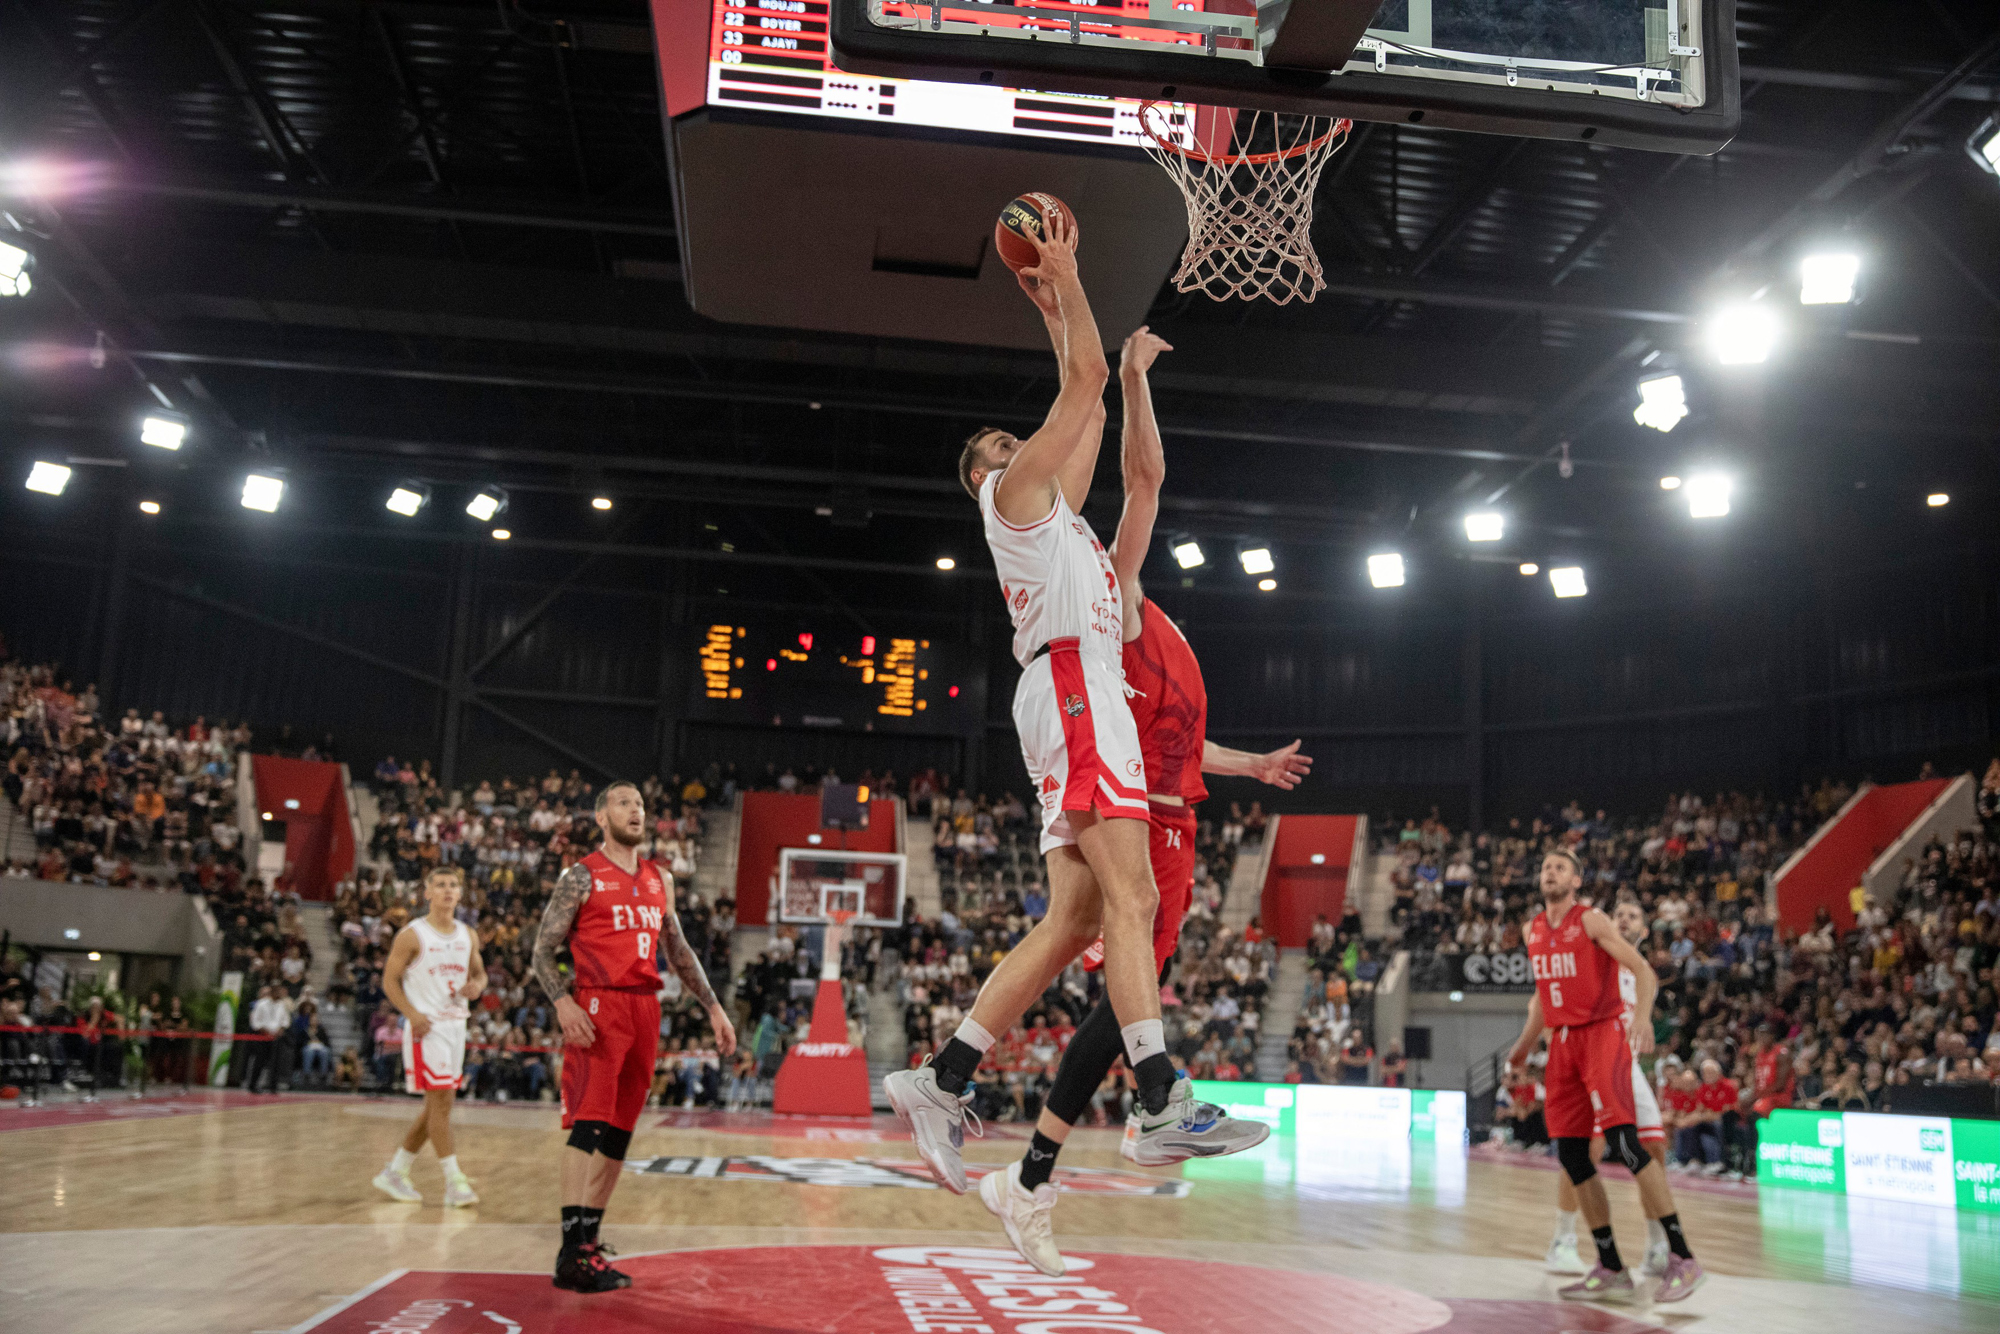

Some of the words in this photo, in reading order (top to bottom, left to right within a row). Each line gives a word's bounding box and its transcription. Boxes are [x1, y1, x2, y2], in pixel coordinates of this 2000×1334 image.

[724, 12, 745, 26] 22
[760, 17, 801, 31] BOYER
[723, 31, 743, 45] 33
[761, 36, 797, 50] AJAYI
[721, 49, 742, 64] 00
[1165, 827, 1182, 850] 14
[612, 904, 662, 931] ELAN
[637, 931, 652, 960] 8
[1532, 951, 1577, 980] ELAN
[589, 997, 600, 1015] 8
[1549, 981, 1564, 1008] 6
[880, 1266, 996, 1334] MUTUELLE
